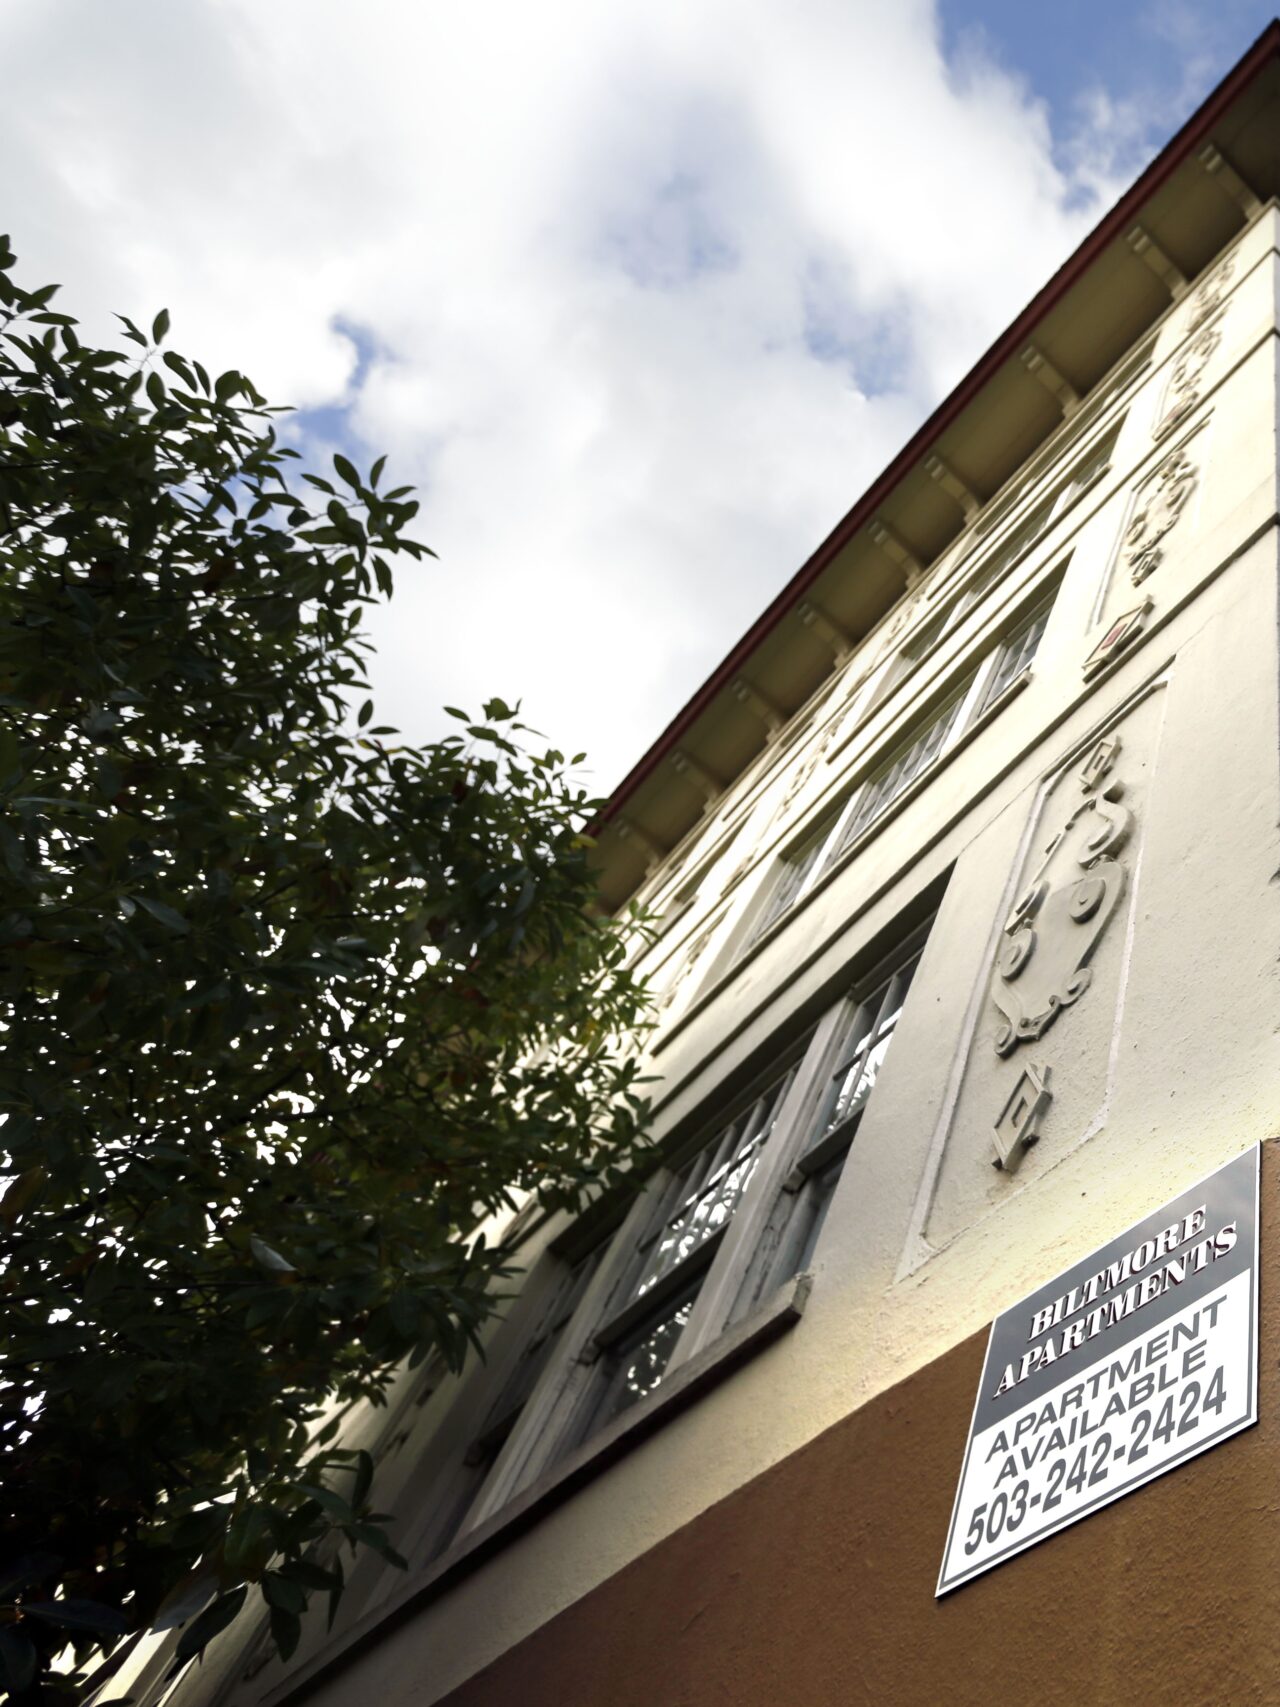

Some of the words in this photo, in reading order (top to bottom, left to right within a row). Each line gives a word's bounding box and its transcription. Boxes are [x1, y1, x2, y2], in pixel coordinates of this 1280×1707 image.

[992, 1221, 1238, 1399] APARTMENTS
[1027, 1204, 1207, 1343] BILTMORE
[964, 1365, 1227, 1555] 503-242-2424
[985, 1295, 1228, 1463] APARTMENT
[993, 1339, 1207, 1489] AVAILABLE
